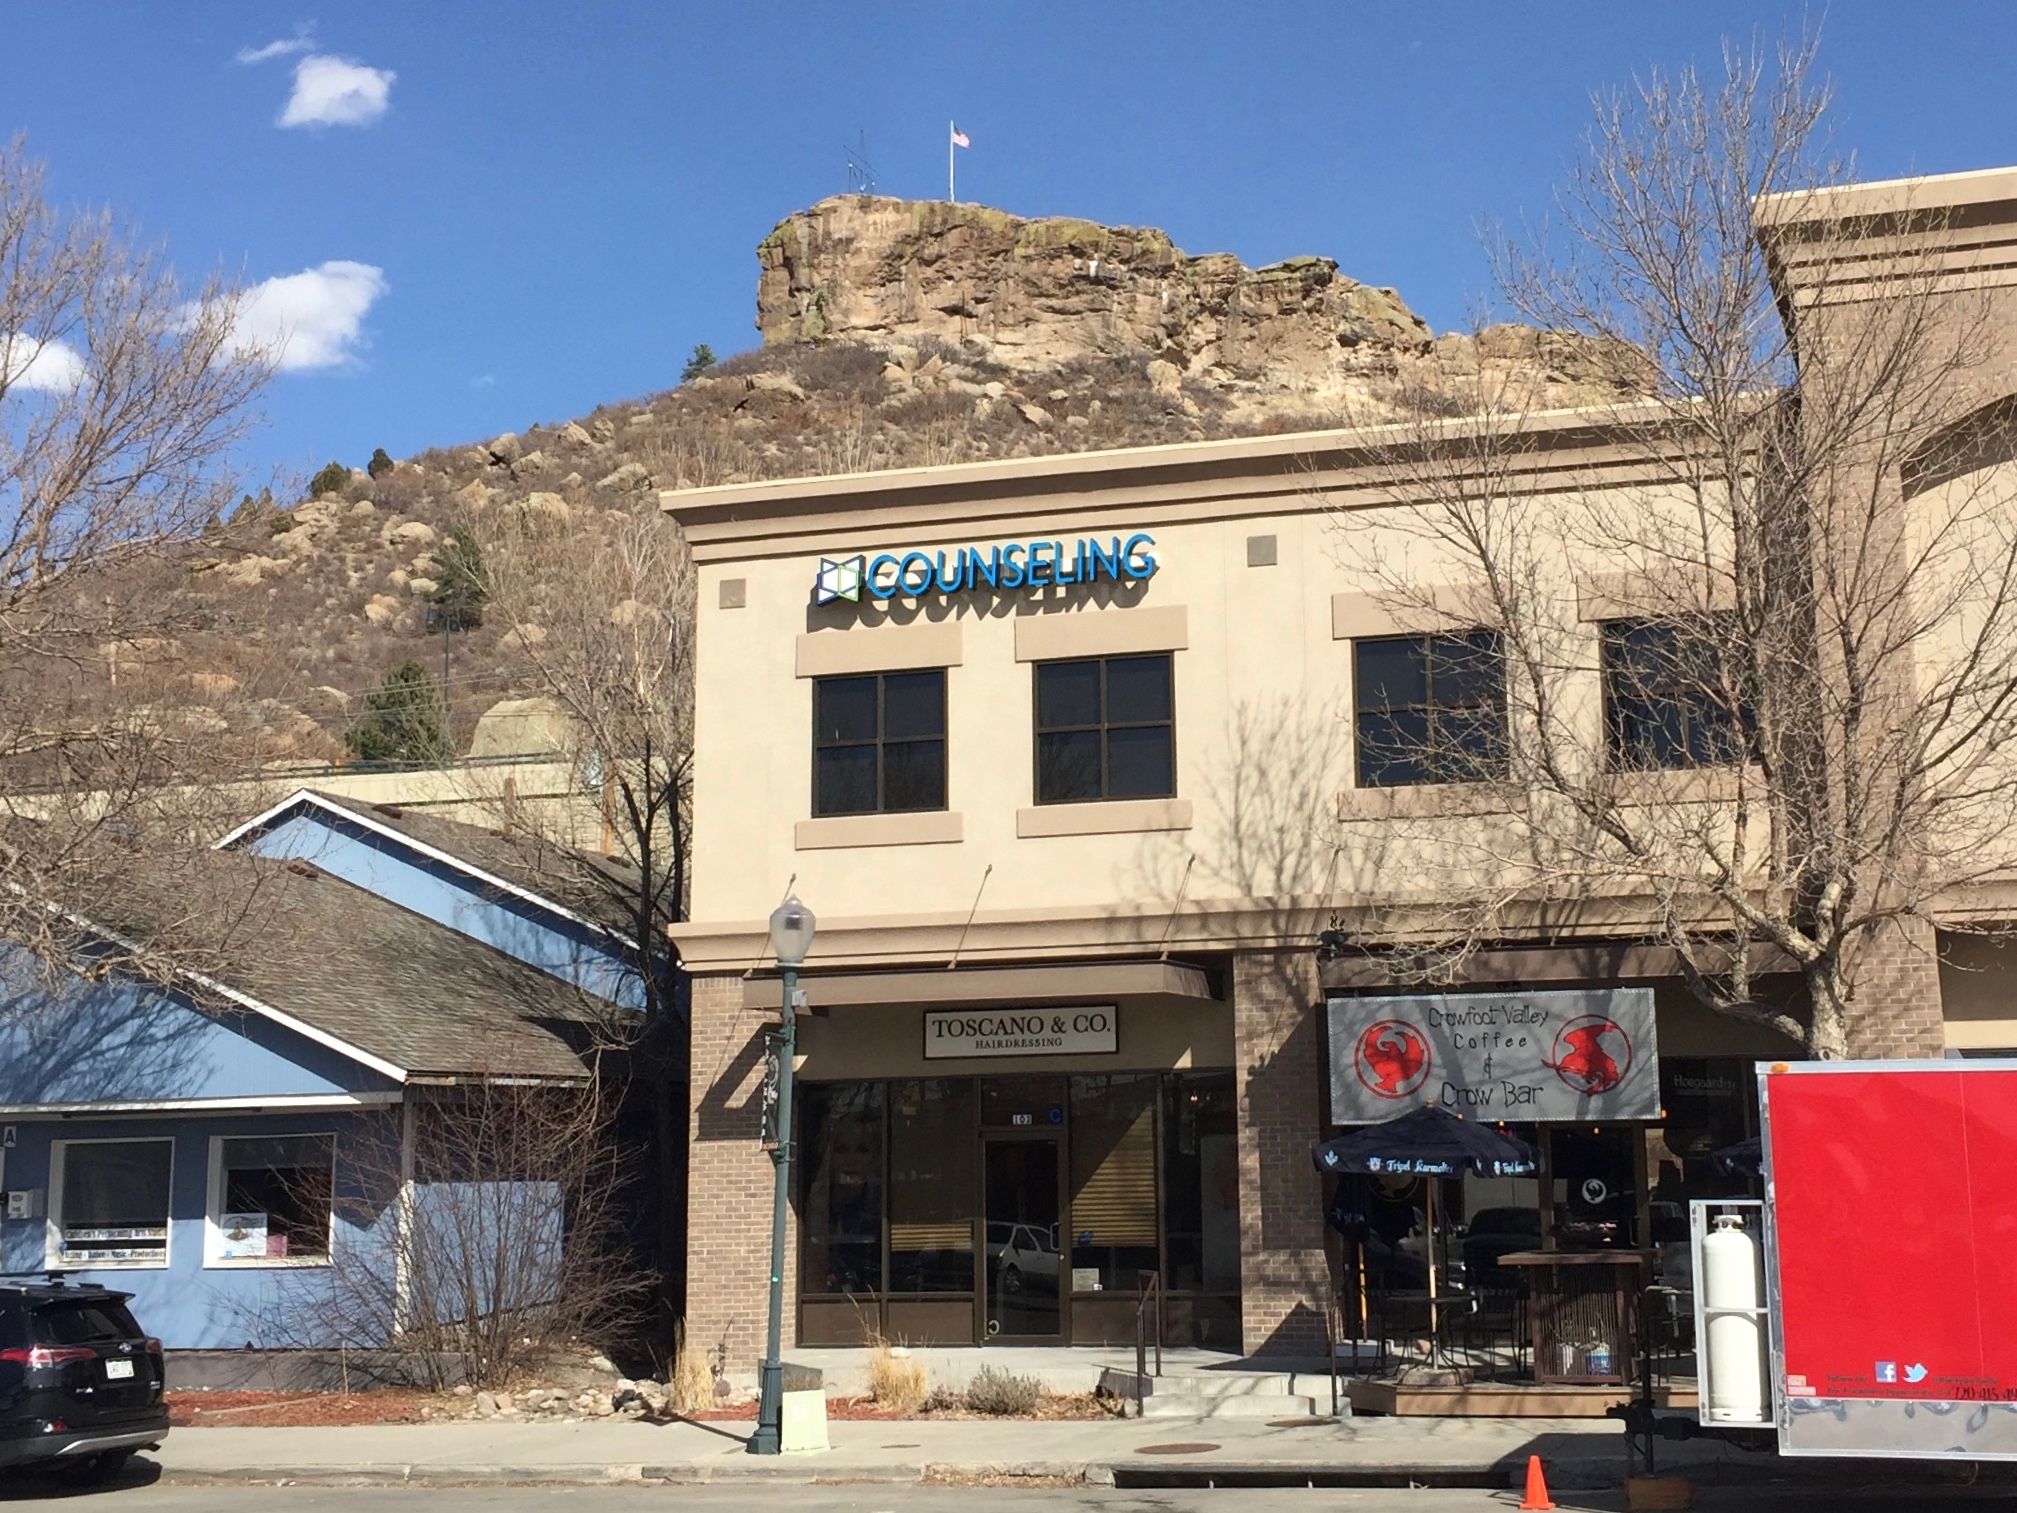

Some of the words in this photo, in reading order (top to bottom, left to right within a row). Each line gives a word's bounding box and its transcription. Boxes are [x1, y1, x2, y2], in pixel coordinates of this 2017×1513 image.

[866, 533, 1157, 599] COUNSELING
[932, 1016, 1045, 1038] TOSCANO
[1051, 1016, 1067, 1034] &
[1073, 1013, 1111, 1034] CO.
[1428, 1005, 1501, 1028] Crowfoot
[1502, 1004, 1549, 1027] Valley
[976, 1037, 1063, 1049] HAIRDRESSING
[1454, 1031, 1527, 1050] Coffee
[1441, 1081, 1493, 1107] Crow
[1500, 1081, 1544, 1108] Bar
[5, 1129, 15, 1143] A
